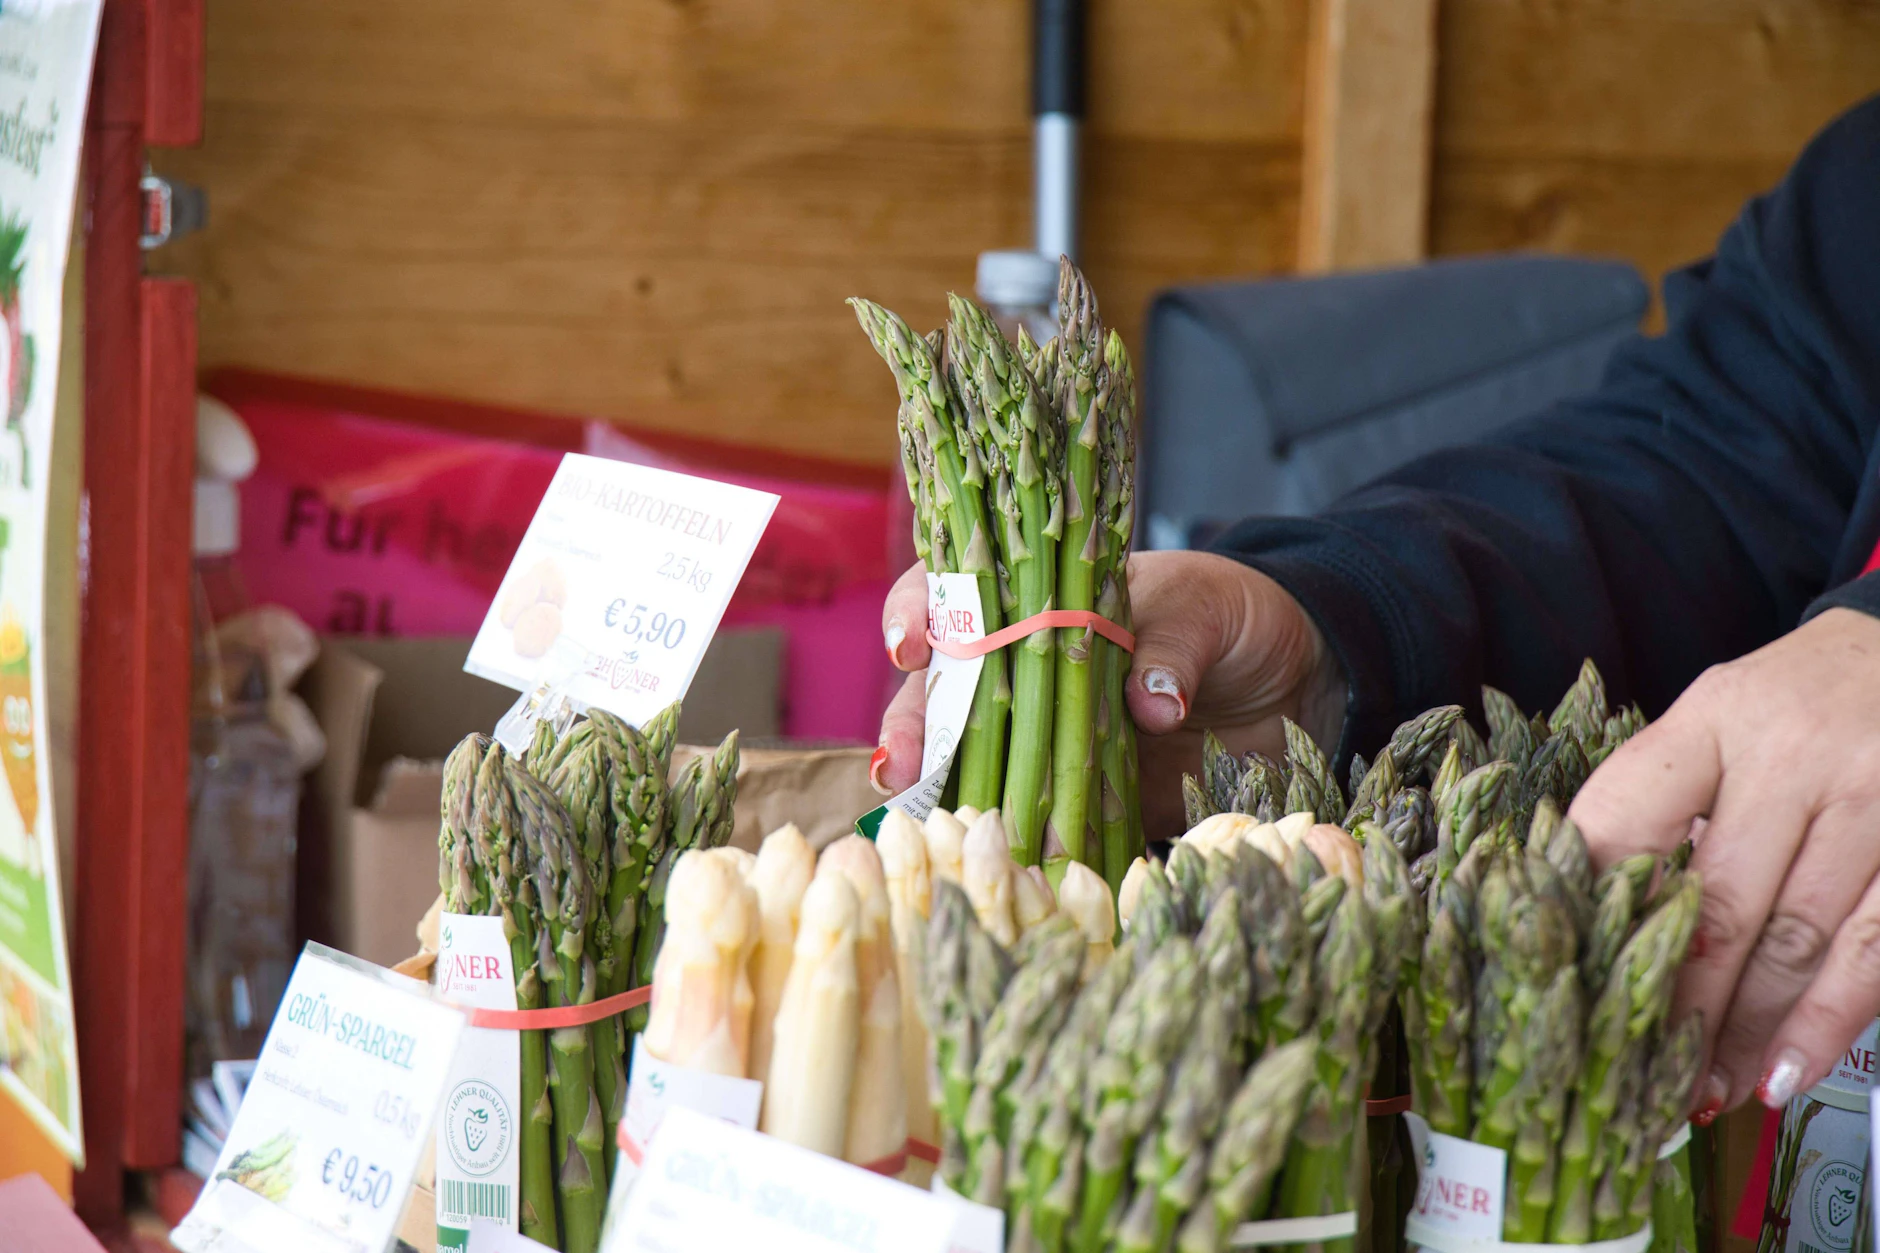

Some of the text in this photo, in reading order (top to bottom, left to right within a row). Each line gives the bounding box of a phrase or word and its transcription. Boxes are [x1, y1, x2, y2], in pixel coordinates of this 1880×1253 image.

[557, 472, 733, 546] BIO-KARTOFFELN
[656, 551, 713, 593] 2,5 kg
[623, 604, 686, 650] 5,90
[902, 803, 916, 815] mit
[455, 953, 503, 980] NER
[287, 992, 418, 1071] GRÜN-SPARGEL
[1838, 1069, 1868, 1084] SEIT 1981
[451, 1086, 508, 1132] LEHNER QUALITÄT
[467, 1158, 489, 1169] Anbau
[489, 1152, 500, 1165] seit
[496, 1134, 507, 1152] 1981
[337, 1154, 394, 1212] 9,50
[1436, 1175, 1490, 1216] NER
[1819, 1167, 1848, 1186] LEHNER
[1826, 1231, 1850, 1244] Anbau
